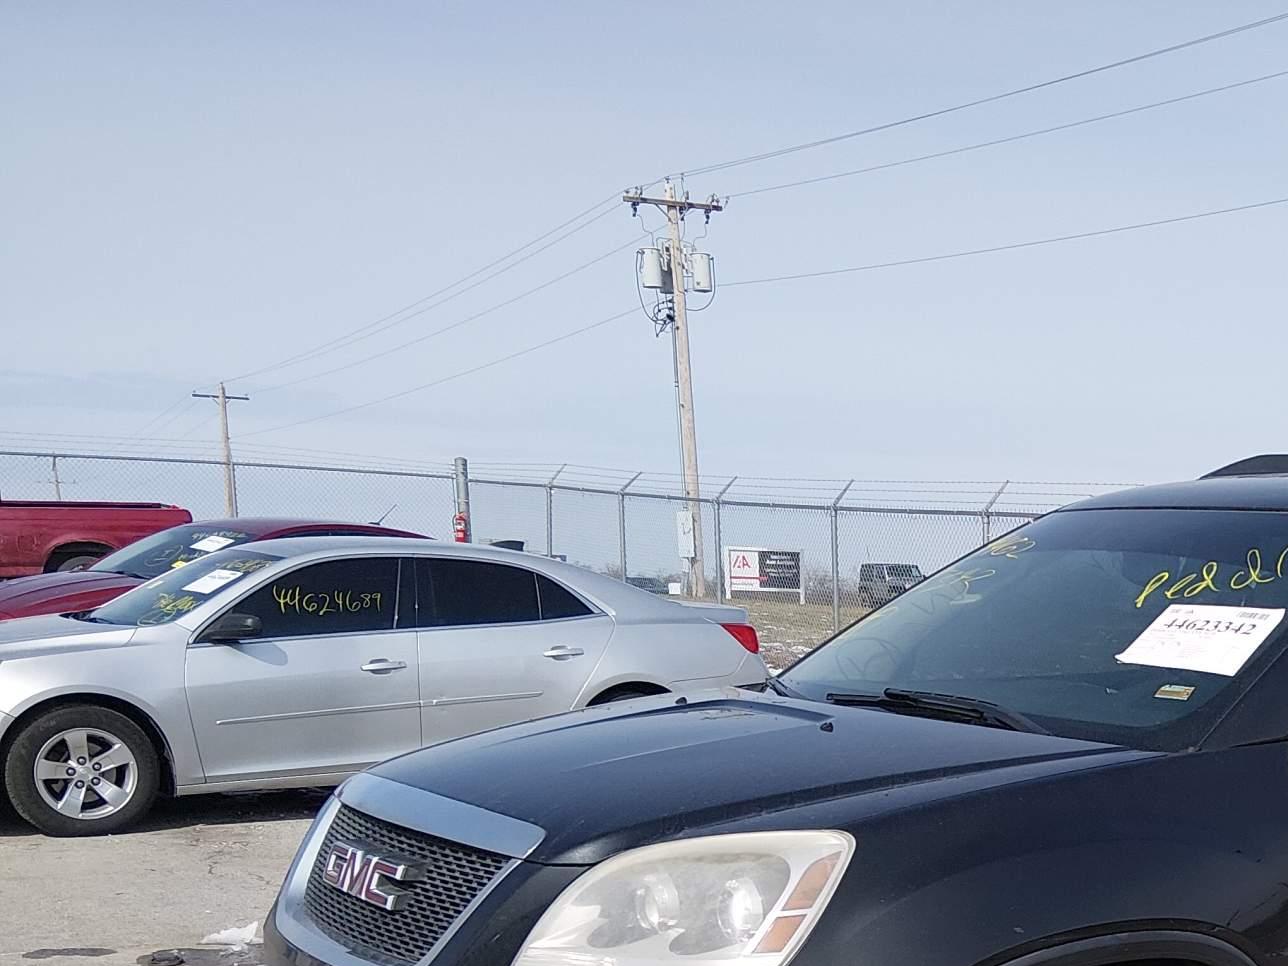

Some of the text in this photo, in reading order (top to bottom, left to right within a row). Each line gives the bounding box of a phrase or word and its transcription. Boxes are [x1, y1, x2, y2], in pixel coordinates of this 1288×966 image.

[273, 585, 381, 615] 44624689
[1163, 617, 1257, 635] 44623342
[323, 841, 406, 911] GMC
